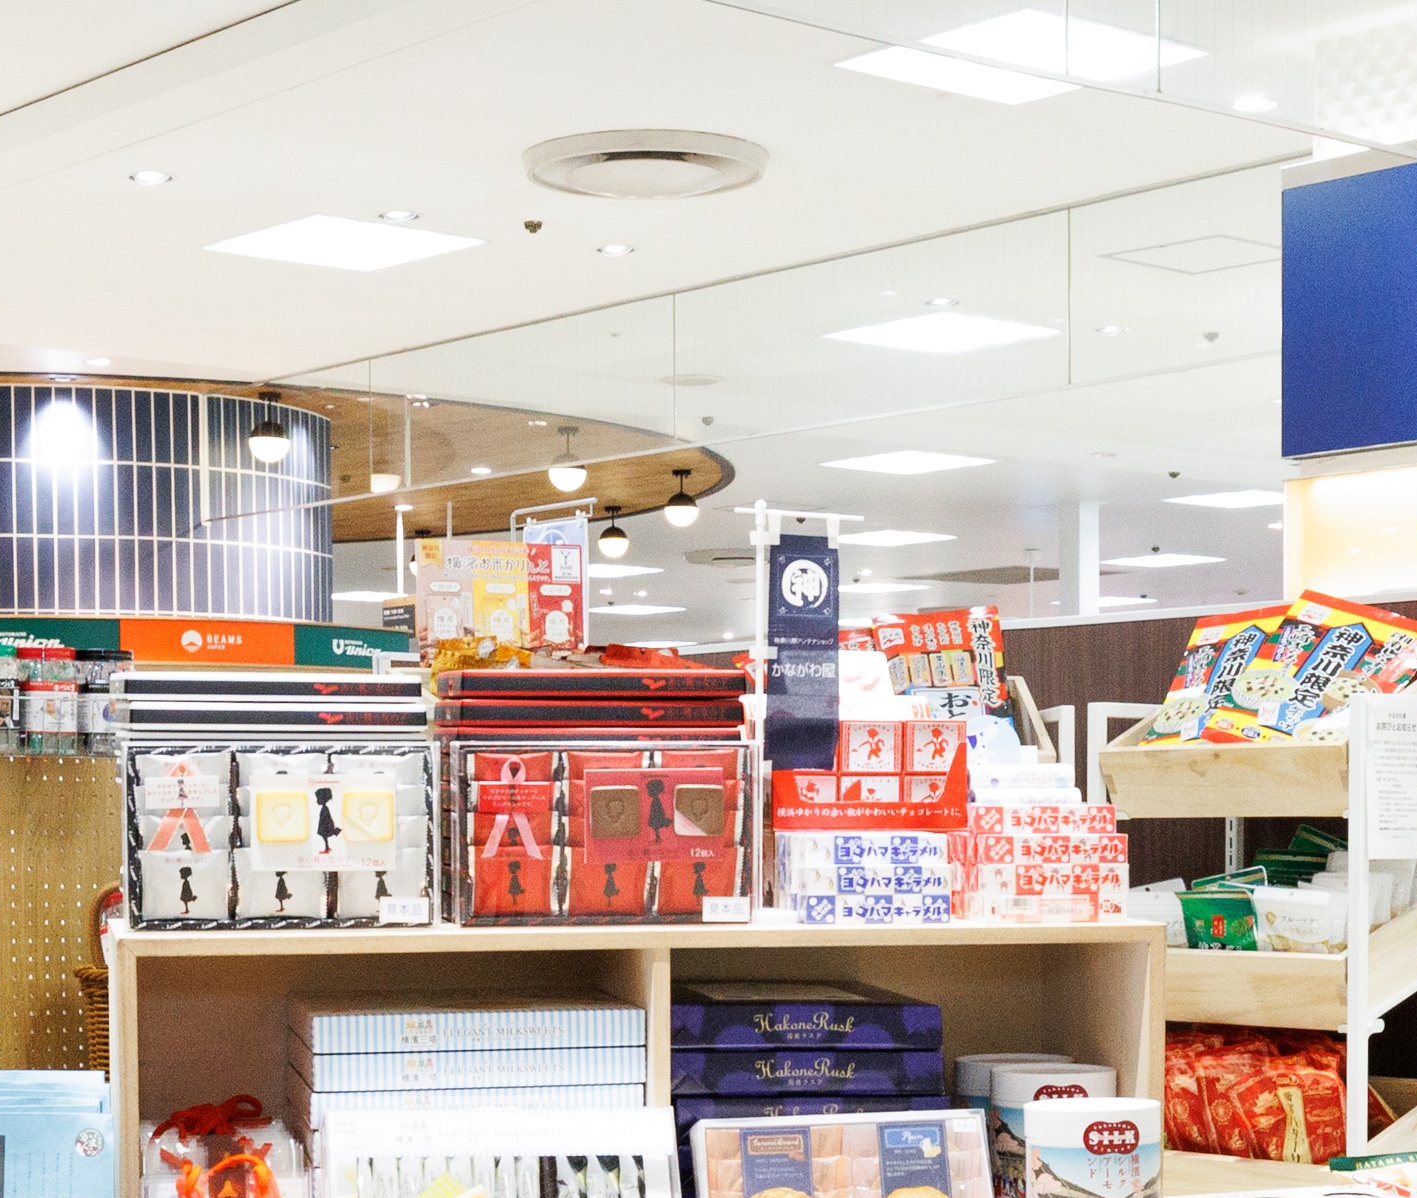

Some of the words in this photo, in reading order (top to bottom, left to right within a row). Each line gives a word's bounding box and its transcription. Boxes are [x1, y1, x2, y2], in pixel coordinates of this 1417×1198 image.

[205, 634, 243, 645] BEAMS
[970, 620, 999, 706] 神奈川限定
[1288, 626, 1365, 709] 神奈川限定
[771, 661, 836, 679] かながわ屋
[1206, 631, 1256, 712] 神奈川限定
[1011, 815, 1109, 827] ヨコハマキャラメル
[689, 848, 716, 859] 12個入
[839, 846, 938, 858] ヨコハマキャラメル
[1021, 843, 1120, 856] ヨコハマキャラメル
[843, 876, 942, 889] ヨコハマキャラメル
[1021, 874, 1120, 886] ヨコハマキャラメル
[386, 903, 424, 917] 見本品
[708, 903, 745, 915] 見本品
[843, 906, 942, 918] ヨコハマキャラメル
[753, 1011, 814, 1033] Hakone
[812, 1009, 856, 1033] Rusk
[443, 1028, 492, 1038] ELEGANT
[496, 1026, 565, 1037] MILKSWEETS
[401, 1036, 438, 1045] 横濱三塔
[444, 1066, 492, 1075] ELEGANT
[755, 1059, 814, 1079] Hakone
[812, 1056, 857, 1079] Rusk
[1088, 1130, 1137, 1145] SILK
